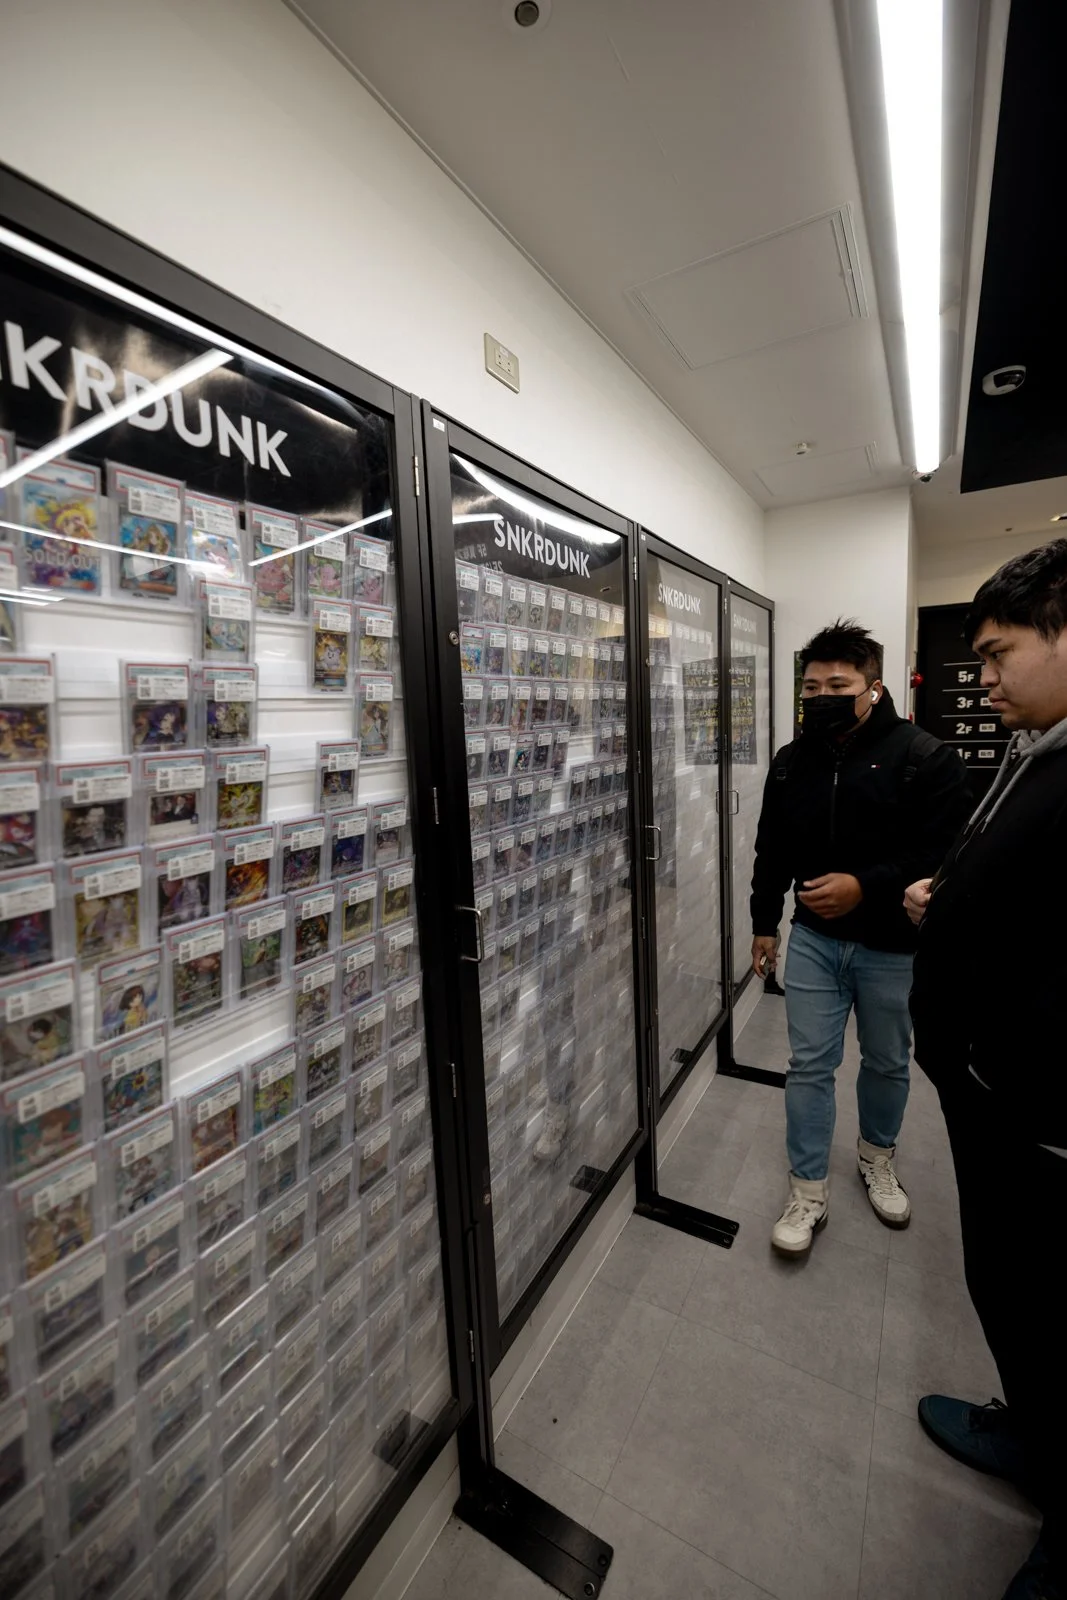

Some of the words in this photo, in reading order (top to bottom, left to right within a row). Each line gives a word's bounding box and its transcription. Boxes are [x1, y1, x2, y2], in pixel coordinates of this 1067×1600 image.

[0, 320, 292, 477] KRDUNK
[494, 519, 590, 578] SNKRDUNK
[25, 548, 66, 567] SOLD
[71, 556, 101, 570] OUT
[658, 582, 701, 615] SNKRDUNK
[958, 671, 975, 683] 5F
[957, 697, 974, 709] 3F
[956, 723, 973, 735] 2F
[957, 748, 972, 760] 1F
